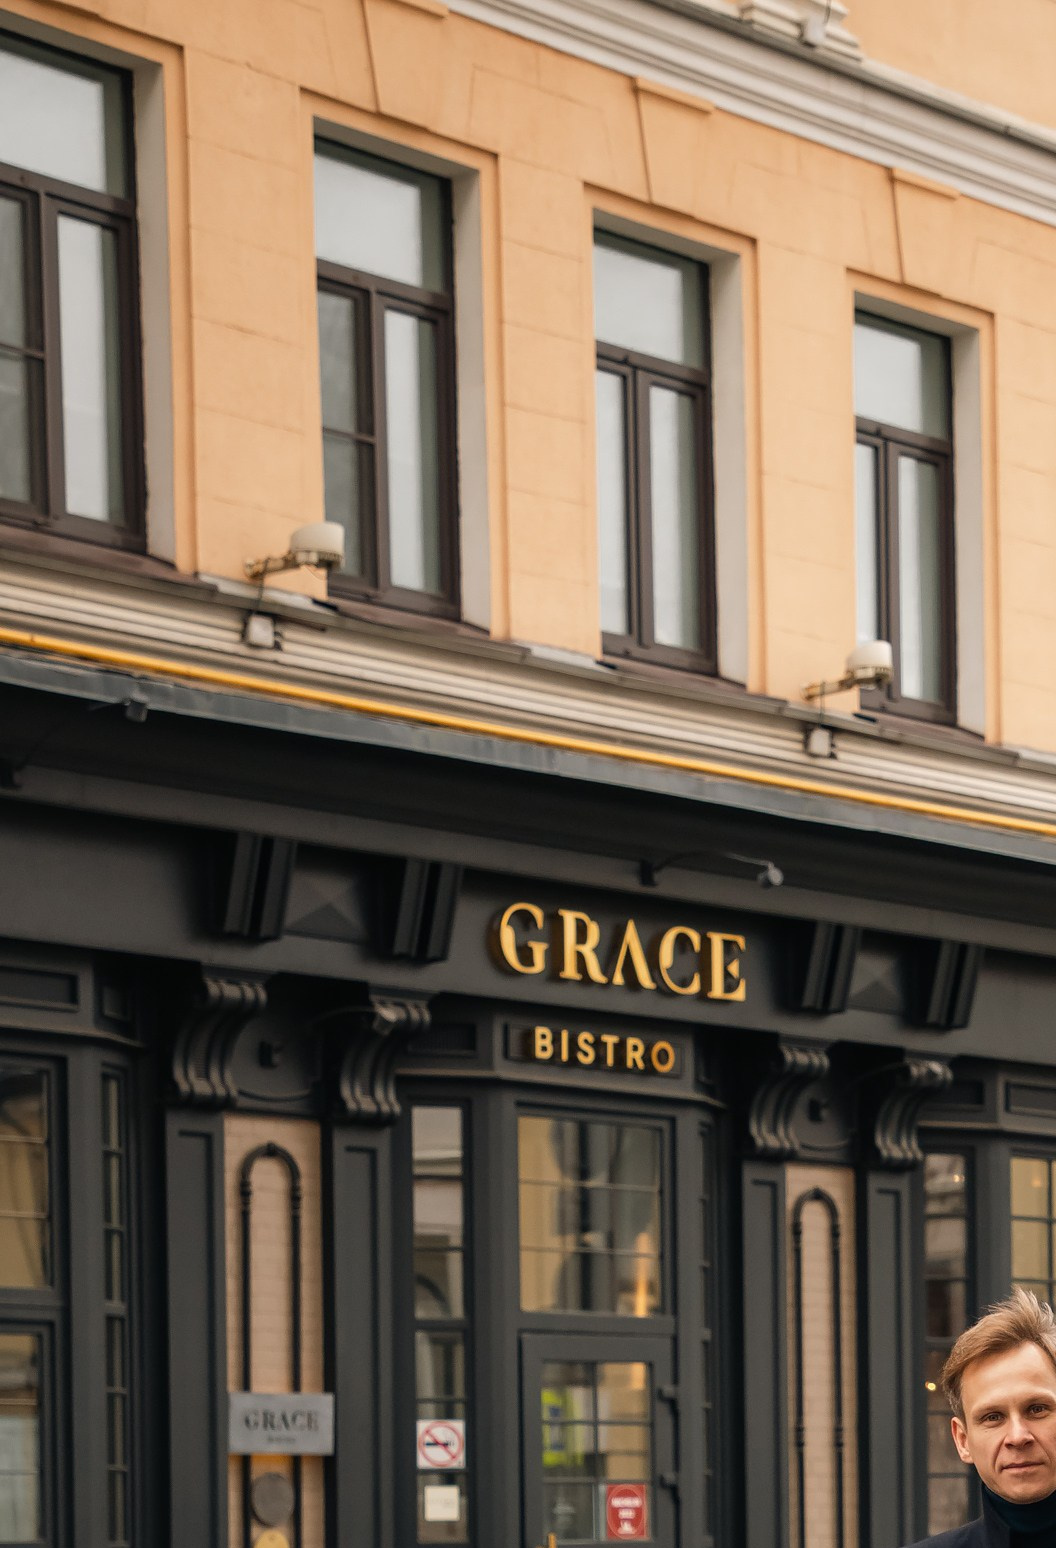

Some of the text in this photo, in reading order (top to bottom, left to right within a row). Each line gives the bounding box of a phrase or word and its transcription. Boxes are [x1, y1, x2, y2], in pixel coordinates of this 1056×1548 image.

[500, 902, 746, 1001] GRACE
[534, 1025, 676, 1073] BISTRO
[244, 1409, 320, 1431] GRACE
